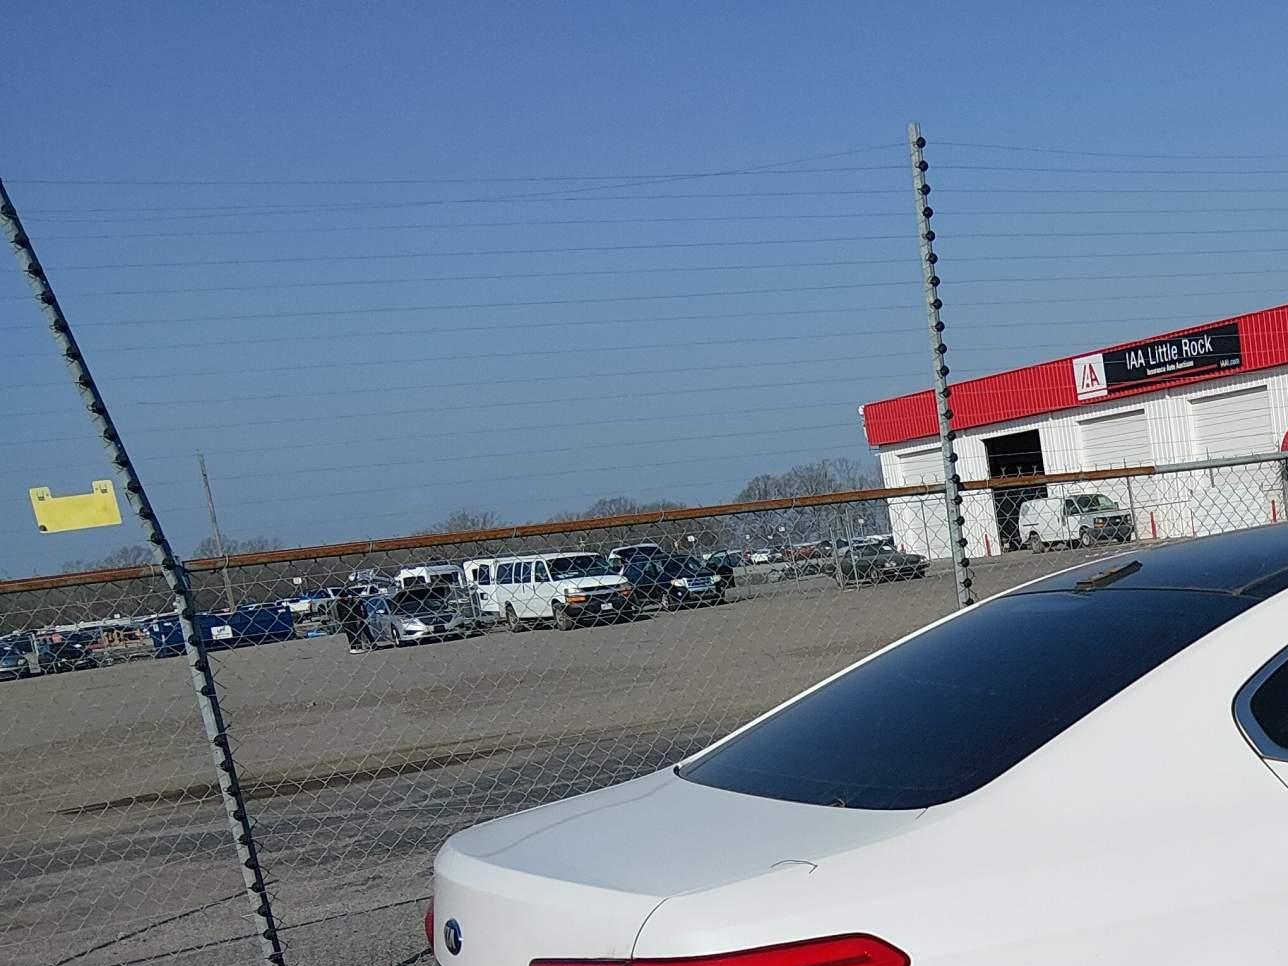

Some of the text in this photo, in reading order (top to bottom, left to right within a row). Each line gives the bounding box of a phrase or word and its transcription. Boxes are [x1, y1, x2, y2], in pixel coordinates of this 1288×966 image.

[1126, 333, 1214, 370] IAA Little Rock
